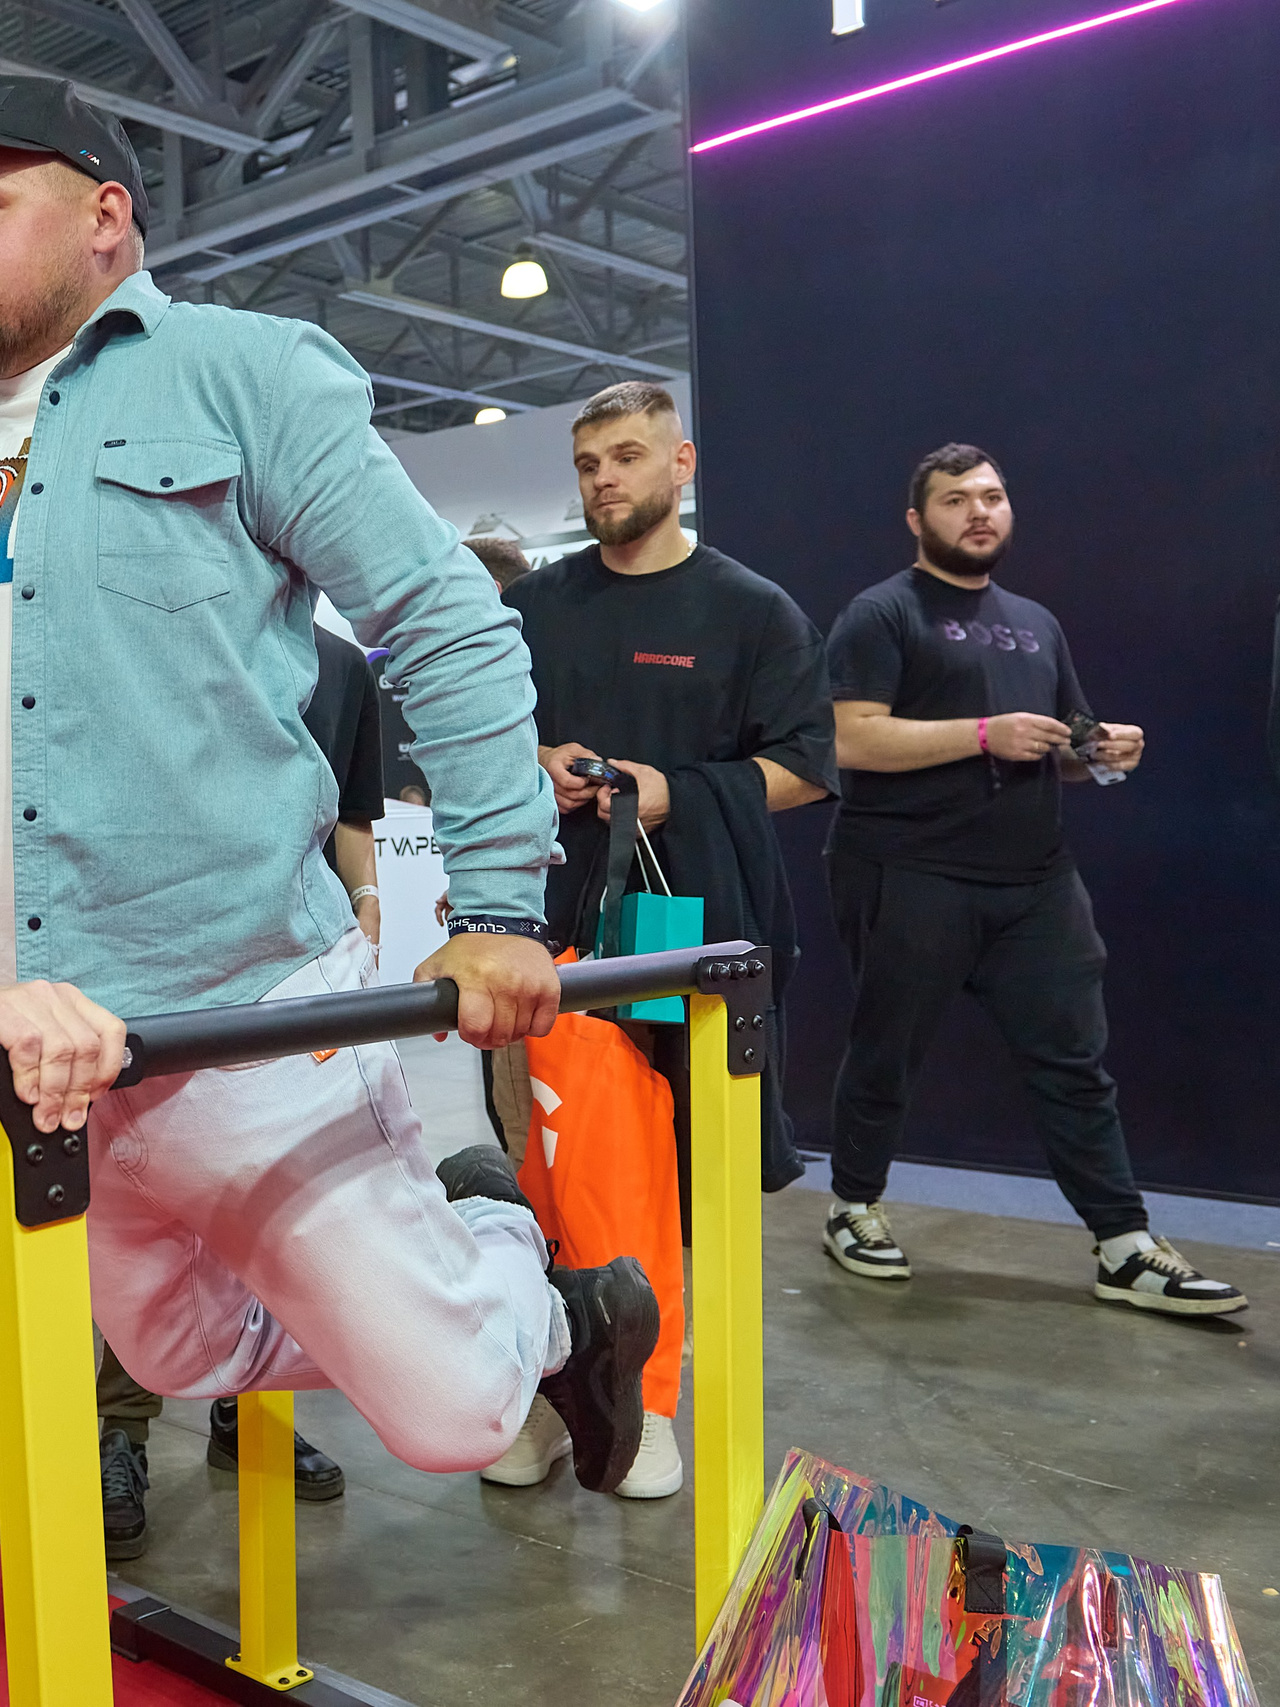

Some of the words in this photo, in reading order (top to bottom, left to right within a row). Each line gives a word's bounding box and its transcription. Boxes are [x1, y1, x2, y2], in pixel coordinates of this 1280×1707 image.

[943, 620, 1040, 653] BOSS
[633, 651, 696, 669] HARDCORE
[391, 836, 441, 856] VAPE
[467, 923, 507, 933] CLUB
